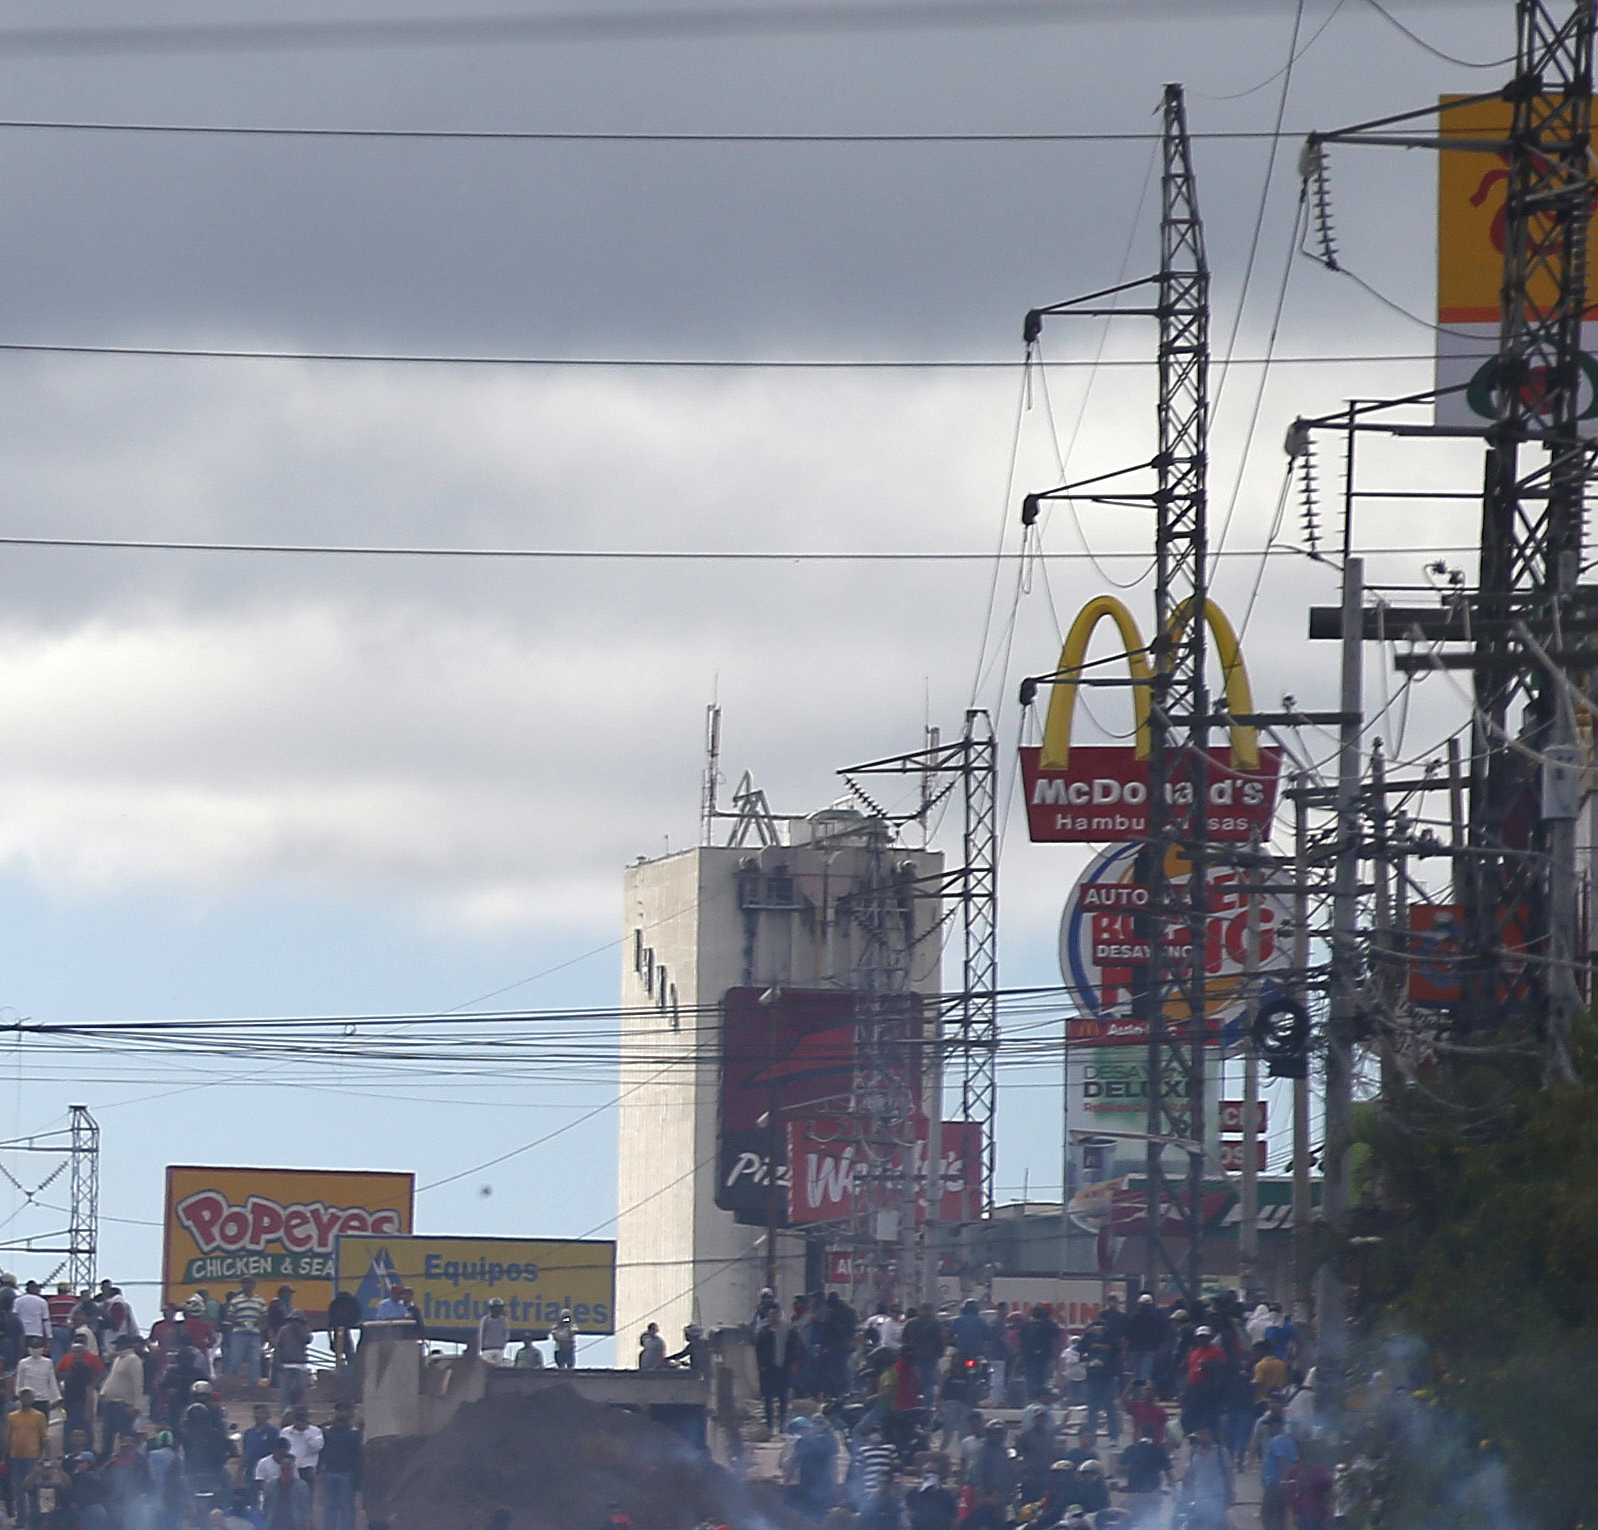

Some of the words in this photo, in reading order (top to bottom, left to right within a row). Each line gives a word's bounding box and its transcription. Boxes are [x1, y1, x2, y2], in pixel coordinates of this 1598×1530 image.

[1032, 778, 1265, 806] McDoad's
[1084, 888, 1149, 906] AUTO
[192, 1256, 273, 1279] CHICKEN
[279, 1259, 294, 1275] &
[424, 1253, 540, 1289] Equipos
